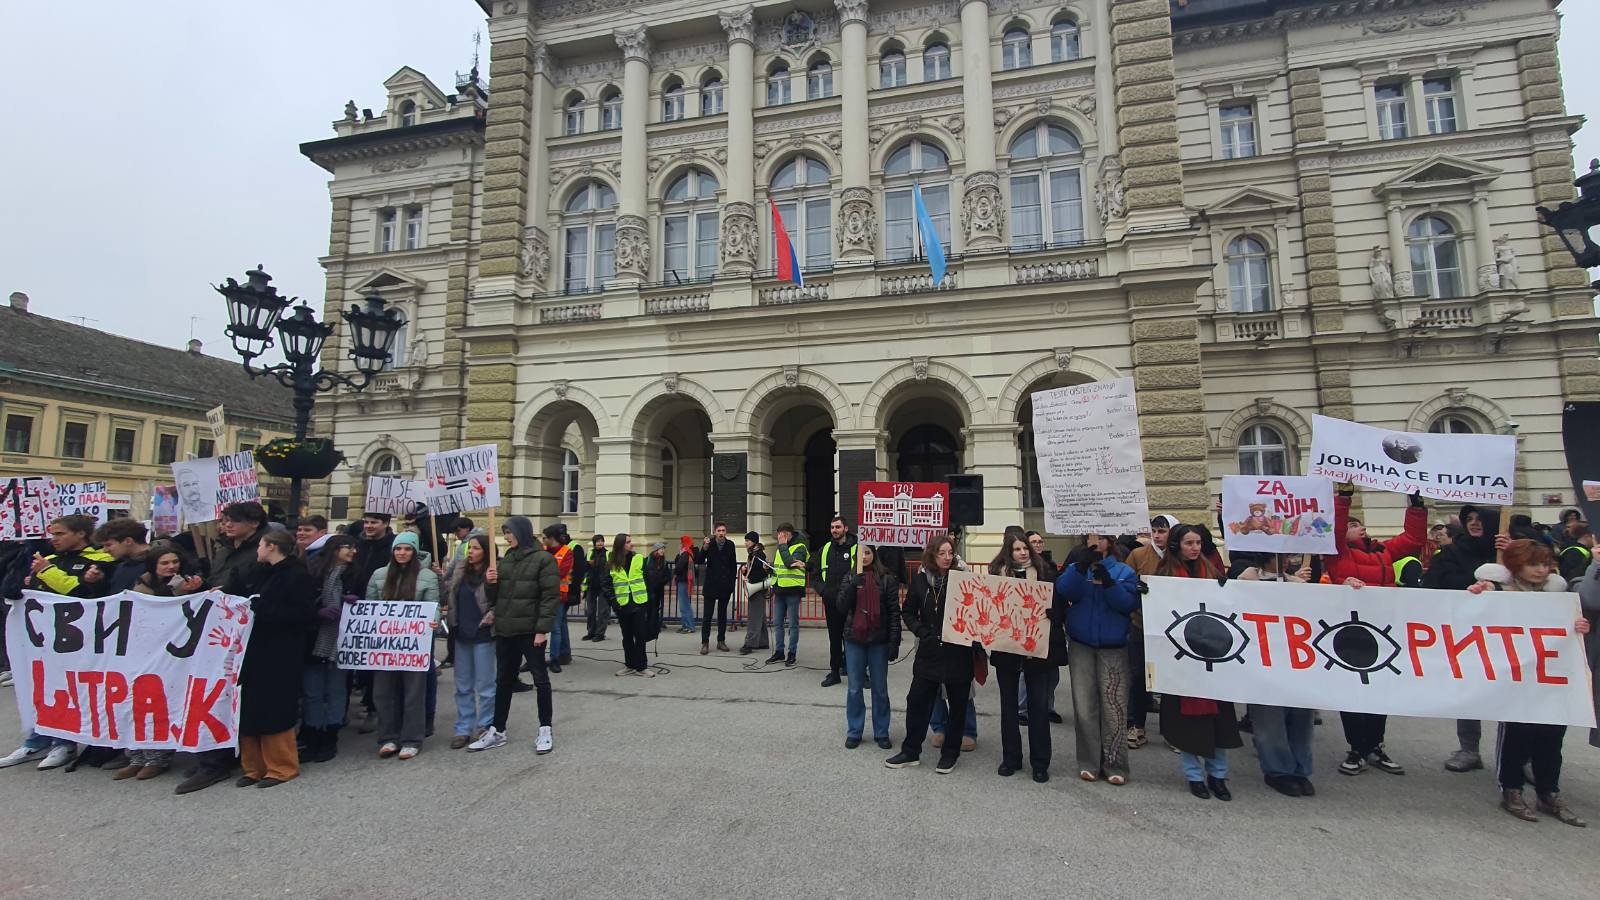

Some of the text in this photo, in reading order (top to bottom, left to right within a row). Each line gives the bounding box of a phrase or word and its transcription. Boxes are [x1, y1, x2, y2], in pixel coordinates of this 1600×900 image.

[1316, 453, 1508, 488] ЈОВИНА СЕ ПИТА
[56, 484, 76, 496] КО
[381, 478, 393, 498] MI
[396, 480, 414, 499] SE
[892, 484, 914, 493] 1703
[1256, 480, 1287, 496] ZA
[1312, 467, 1513, 500] Змајићи су уз студенте!
[368, 496, 416, 514] PITAMO
[898, 528, 909, 543] СУ
[349, 602, 379, 616] СВЕТ
[380, 601, 398, 616] ЈЕ
[24, 598, 214, 658] СВИ У
[345, 619, 377, 635] КАДА
[388, 636, 419, 652] КАДА
[337, 651, 430, 668] СНОВЕ ОСТВАРУЈЕМО
